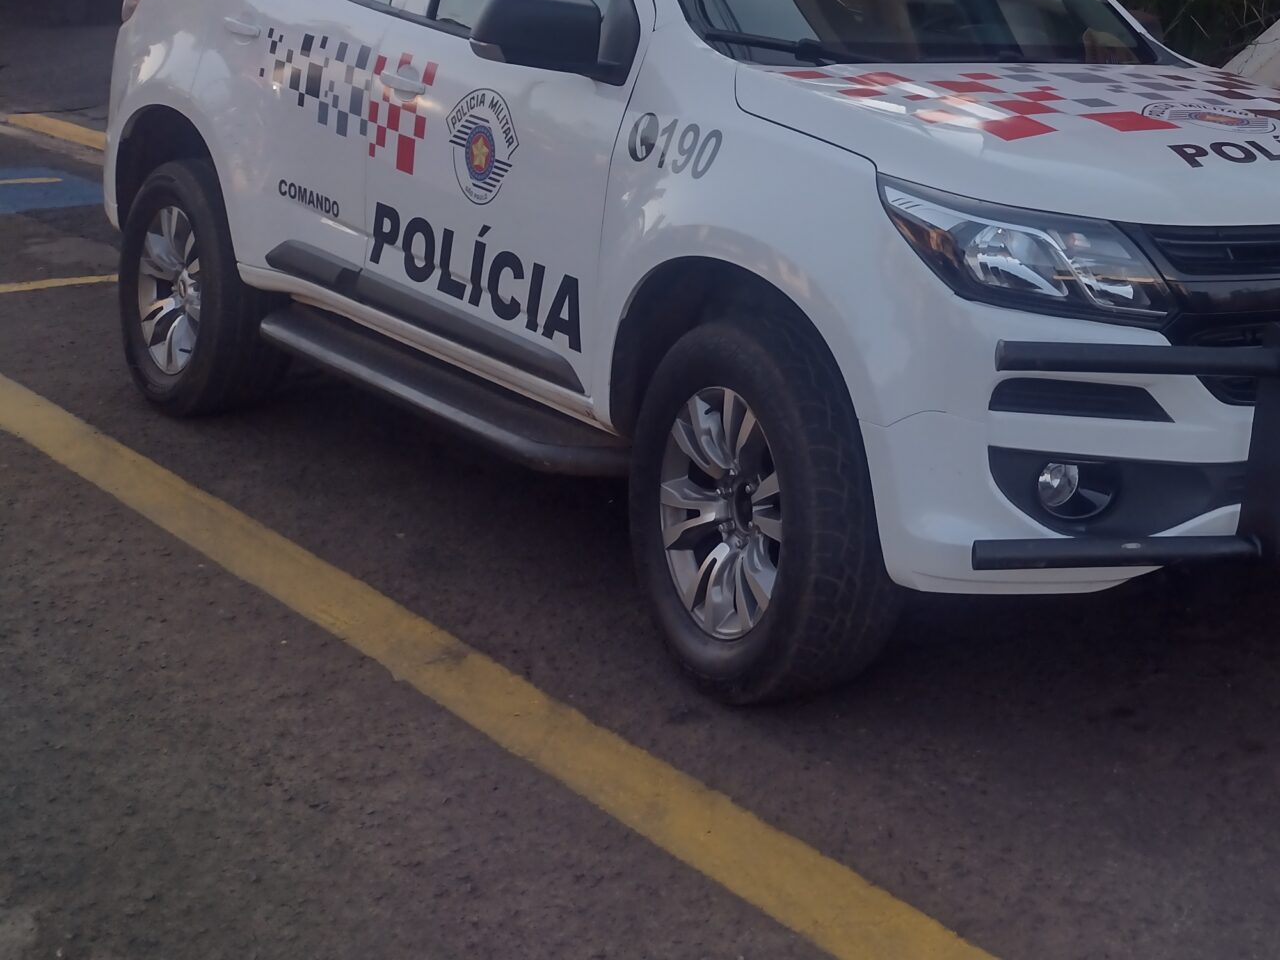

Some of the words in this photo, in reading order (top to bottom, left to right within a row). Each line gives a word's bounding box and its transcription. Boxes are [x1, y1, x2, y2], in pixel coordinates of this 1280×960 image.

[488, 96, 515, 149] MILITAR
[658, 118, 722, 179] 190
[278, 179, 340, 218] COMANDO
[369, 201, 582, 353] POLÍCIA
